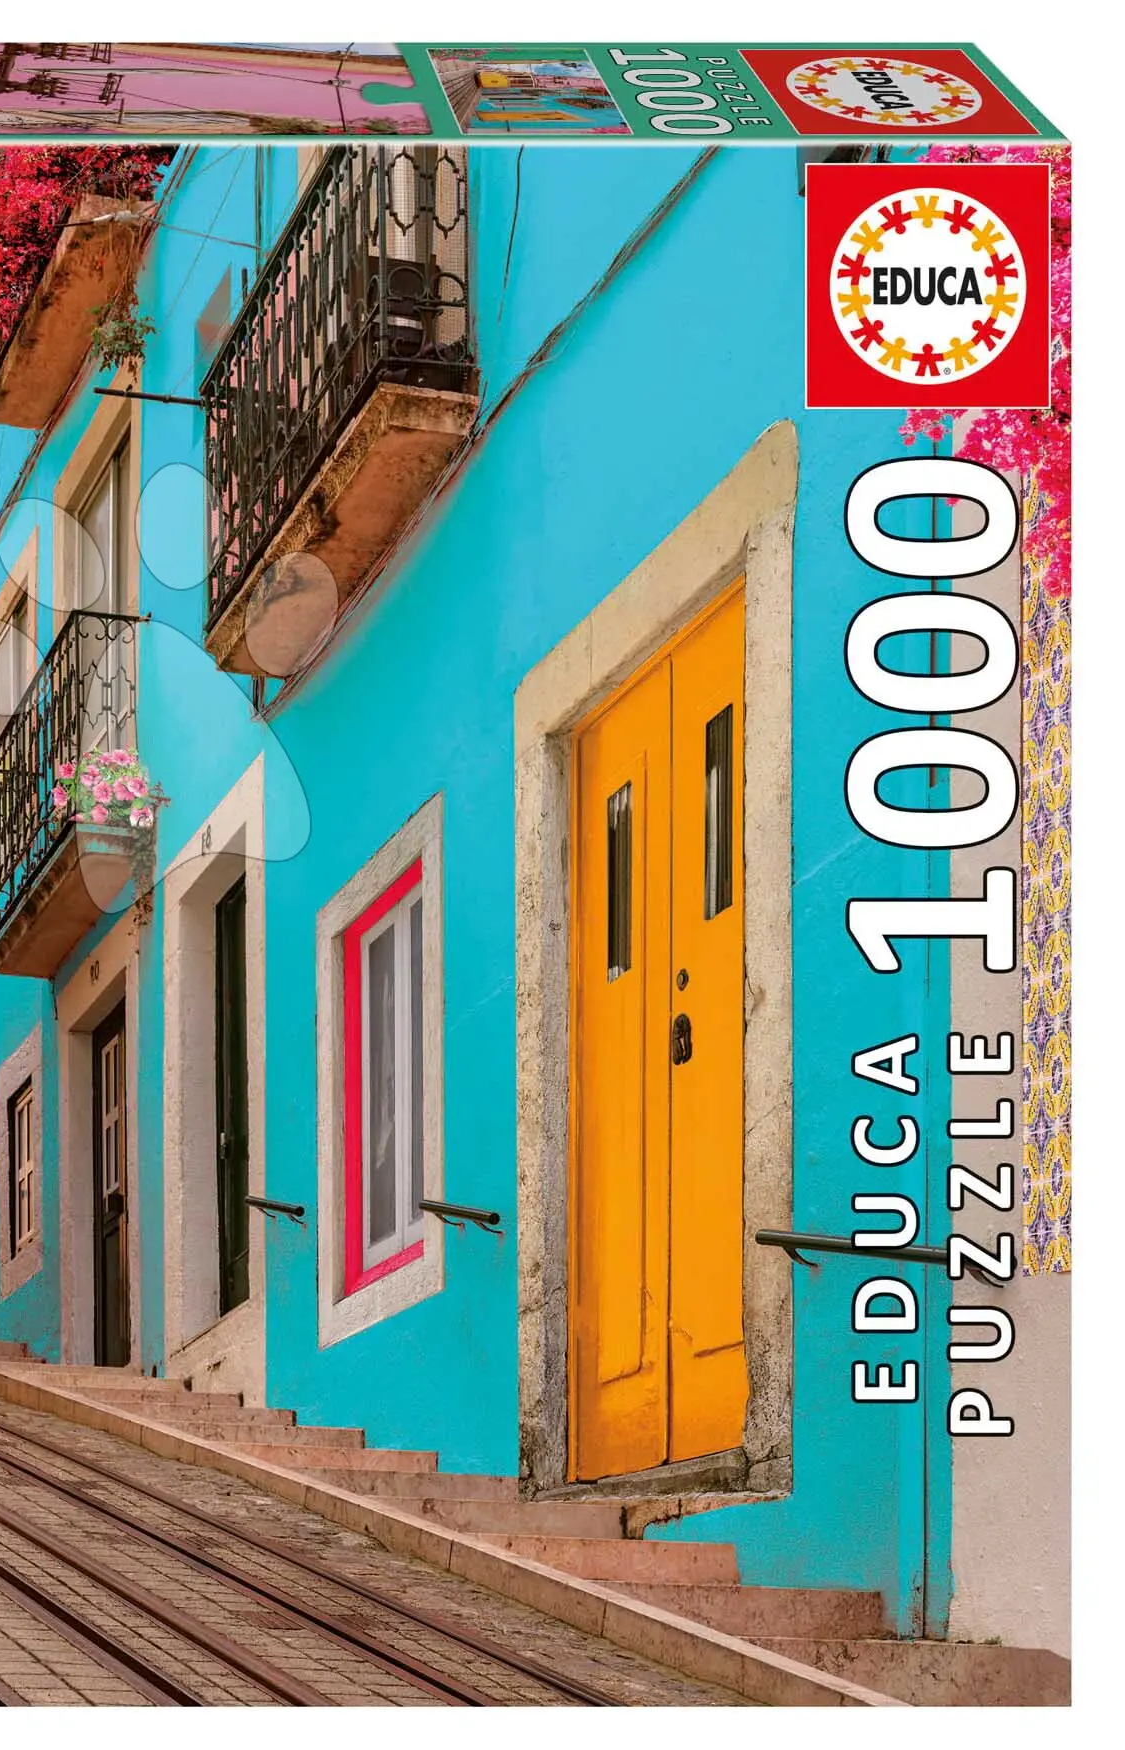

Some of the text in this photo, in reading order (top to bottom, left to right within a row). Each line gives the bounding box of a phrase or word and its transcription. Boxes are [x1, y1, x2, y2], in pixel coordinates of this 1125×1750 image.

[607, 48, 735, 136] 1000
[696, 56, 773, 126] PUZZLE
[851, 71, 915, 111] EDUCA
[873, 266, 983, 306] EDUCA
[844, 455, 1021, 975] 1000
[851, 1033, 920, 1405] EDUCA
[947, 1030, 1016, 1440] PUZZLE
